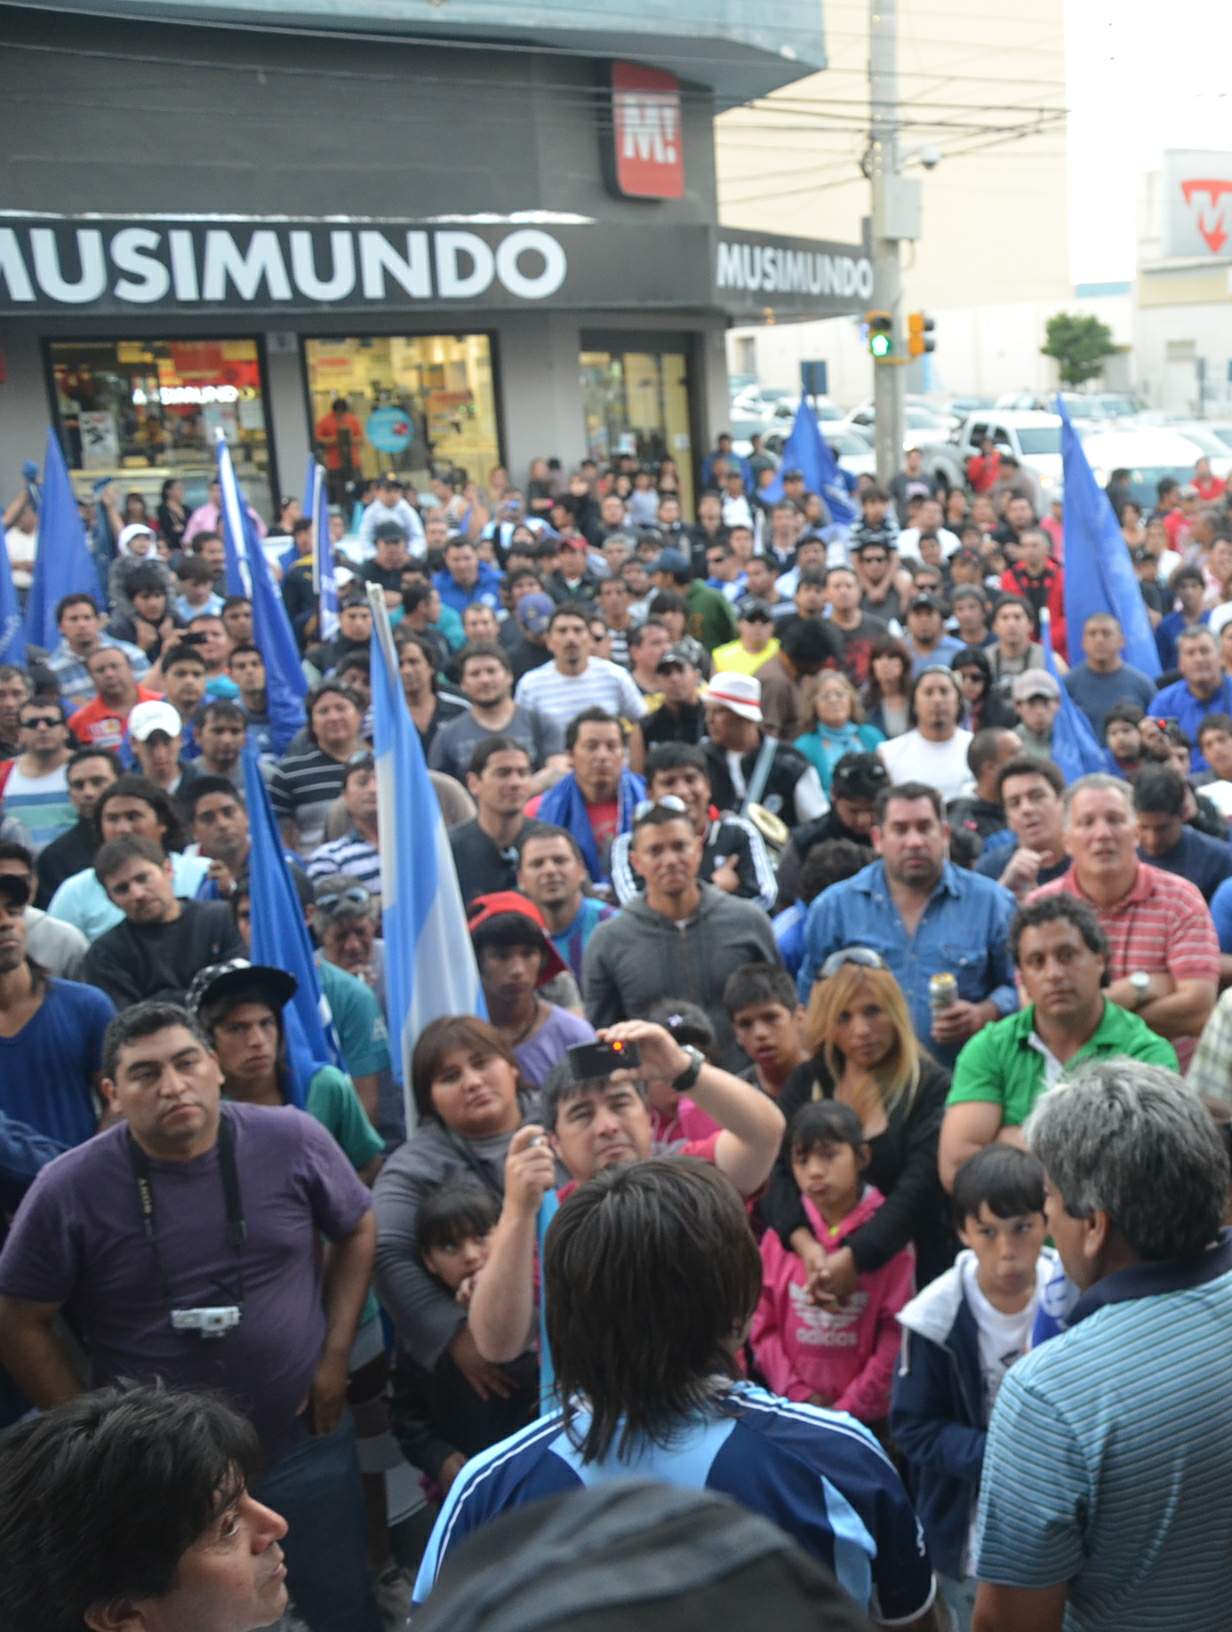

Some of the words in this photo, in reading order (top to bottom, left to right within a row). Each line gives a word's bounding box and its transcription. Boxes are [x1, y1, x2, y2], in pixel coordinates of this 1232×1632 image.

[623, 91, 677, 165] M!
[716, 241, 874, 300] MUSIMUNDO
[795, 1327, 859, 1348] adidas
